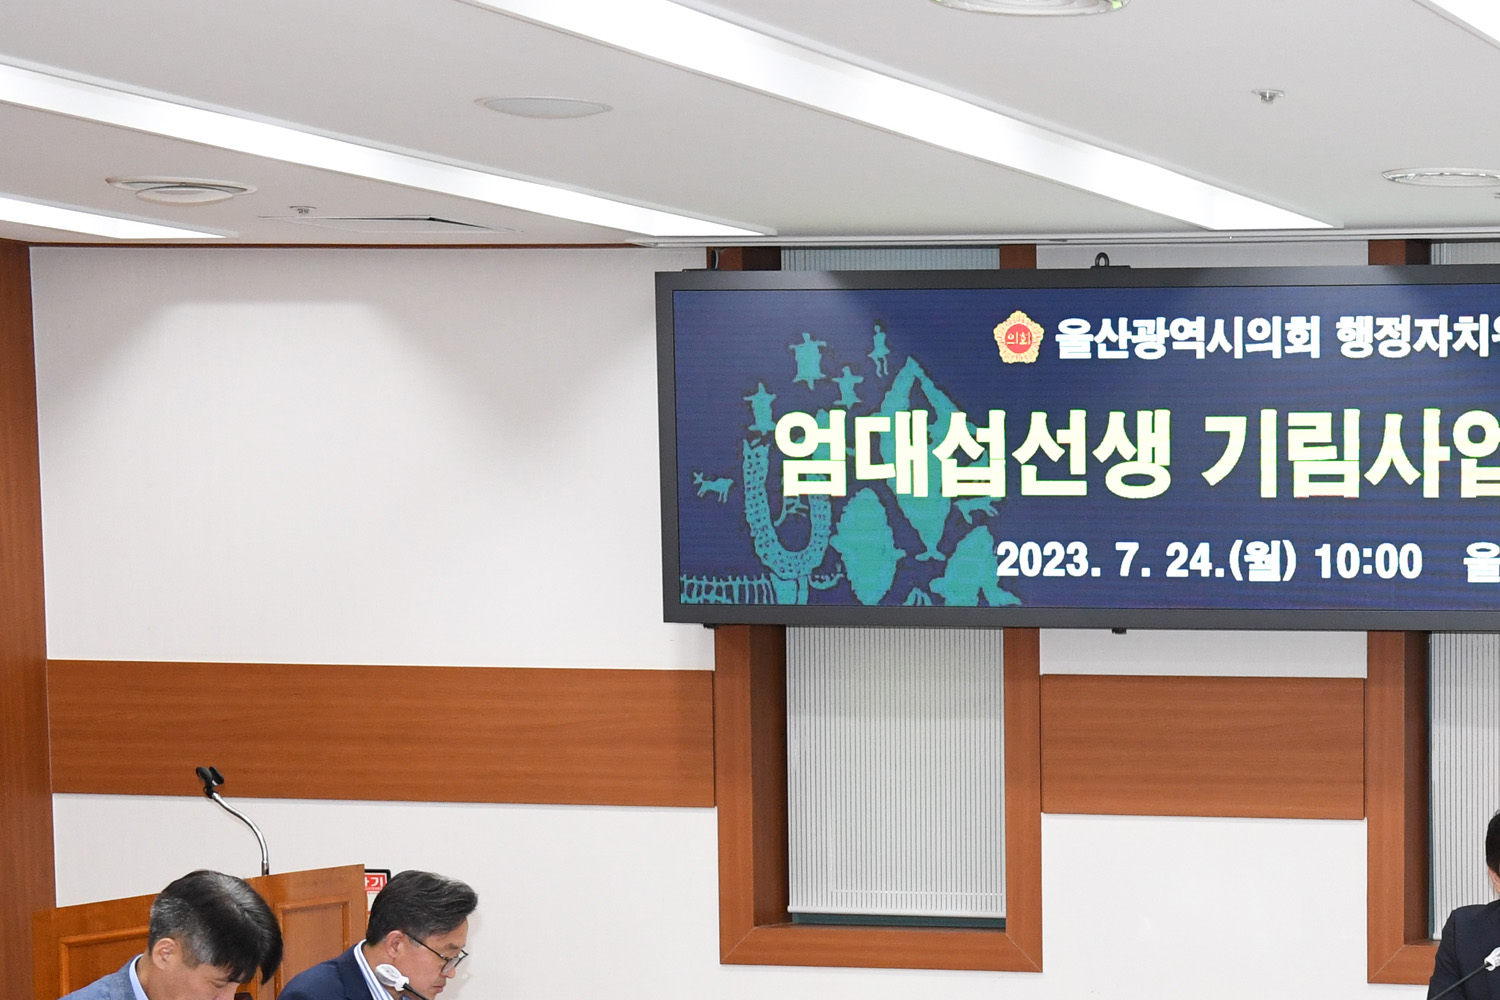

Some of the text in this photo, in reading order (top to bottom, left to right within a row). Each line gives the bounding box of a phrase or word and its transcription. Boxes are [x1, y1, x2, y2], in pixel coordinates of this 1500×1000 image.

[1055, 315, 1321, 360] 울산광역시의회
[774, 408, 1172, 499] 엄대섭선생
[996, 541, 1101, 577] 2023.
[1115, 541, 1151, 577] 7.
[1166, 539, 1297, 582] 24.(월)
[1314, 542, 1423, 579] 10:00
